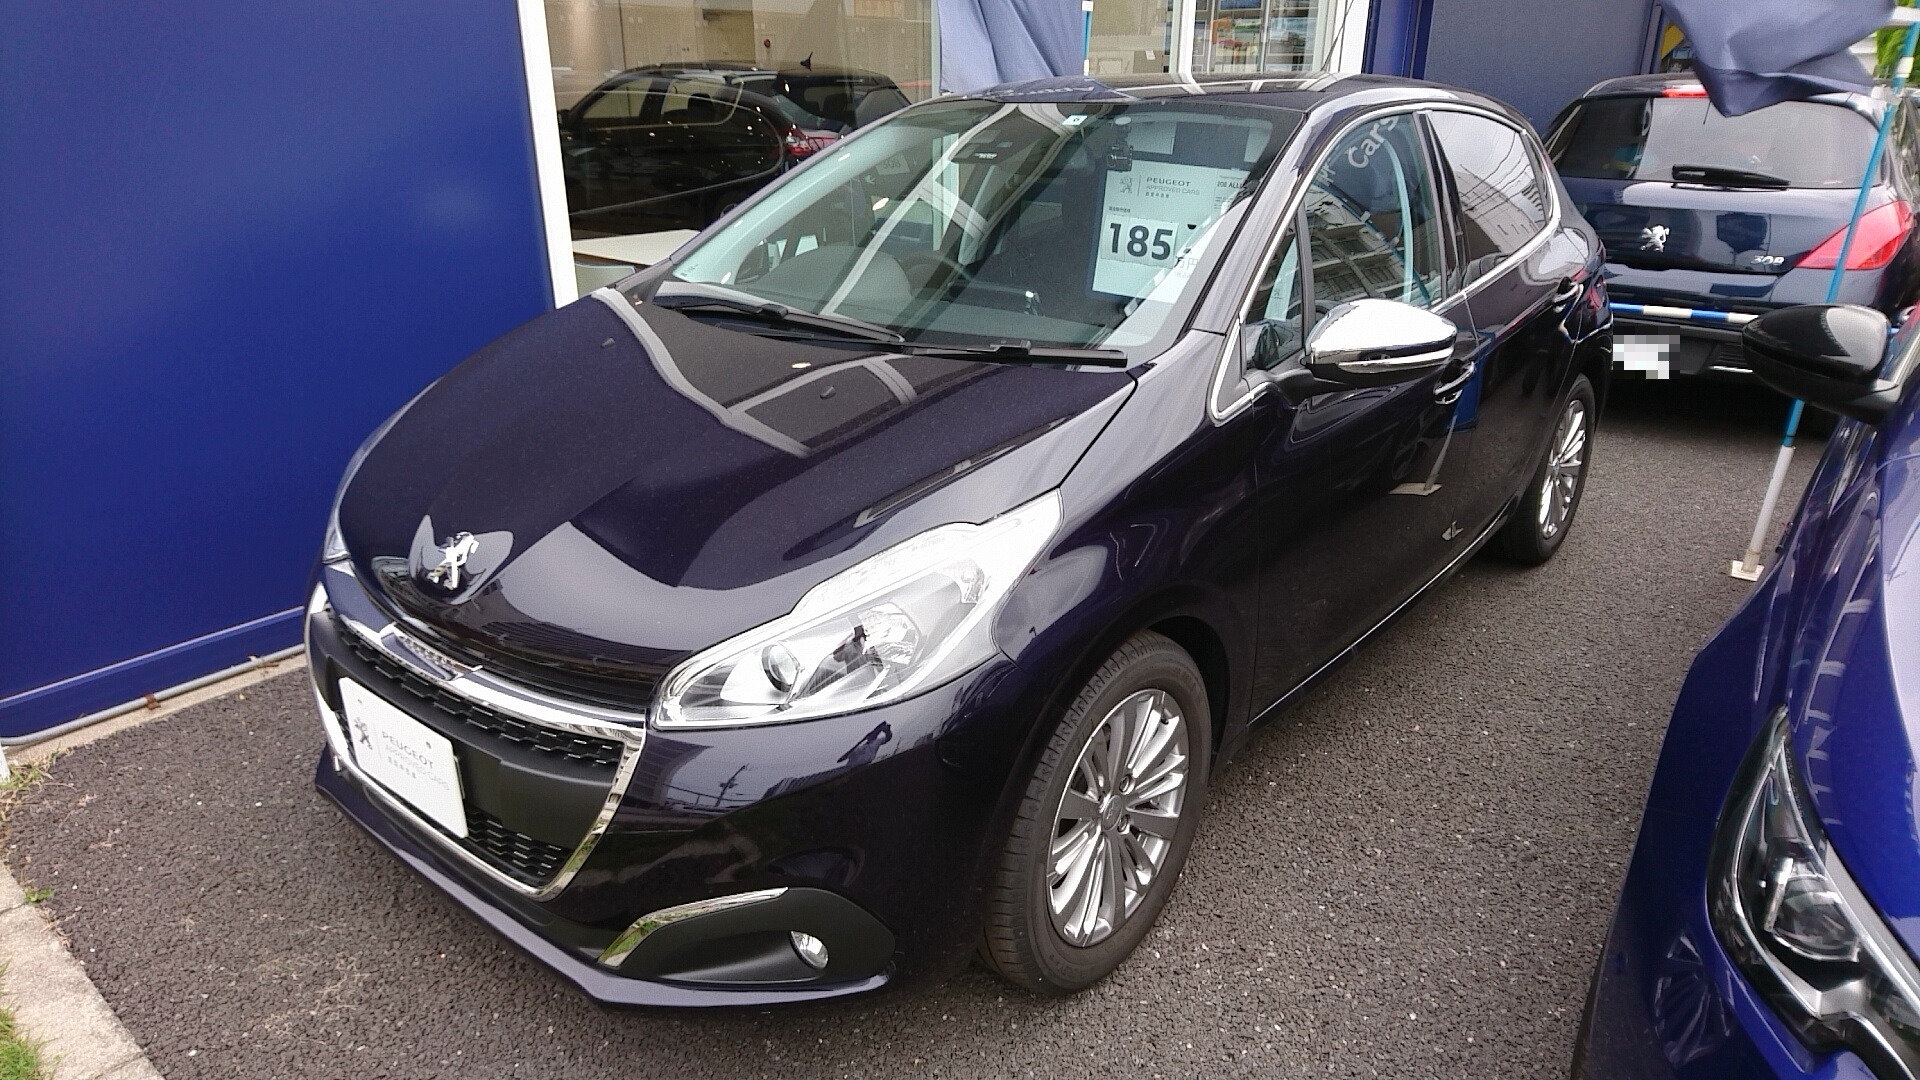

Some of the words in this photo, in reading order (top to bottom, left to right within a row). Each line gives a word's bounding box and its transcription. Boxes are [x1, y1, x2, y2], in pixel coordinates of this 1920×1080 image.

[1146, 177, 1191, 187] PEUGEOT
[1146, 185, 1181, 194] APPROVED
[1181, 188, 1200, 196] CARS
[1110, 223, 1173, 261] 185
[1750, 255, 1785, 266] 308
[381, 730, 434, 769] PEUGEOT
